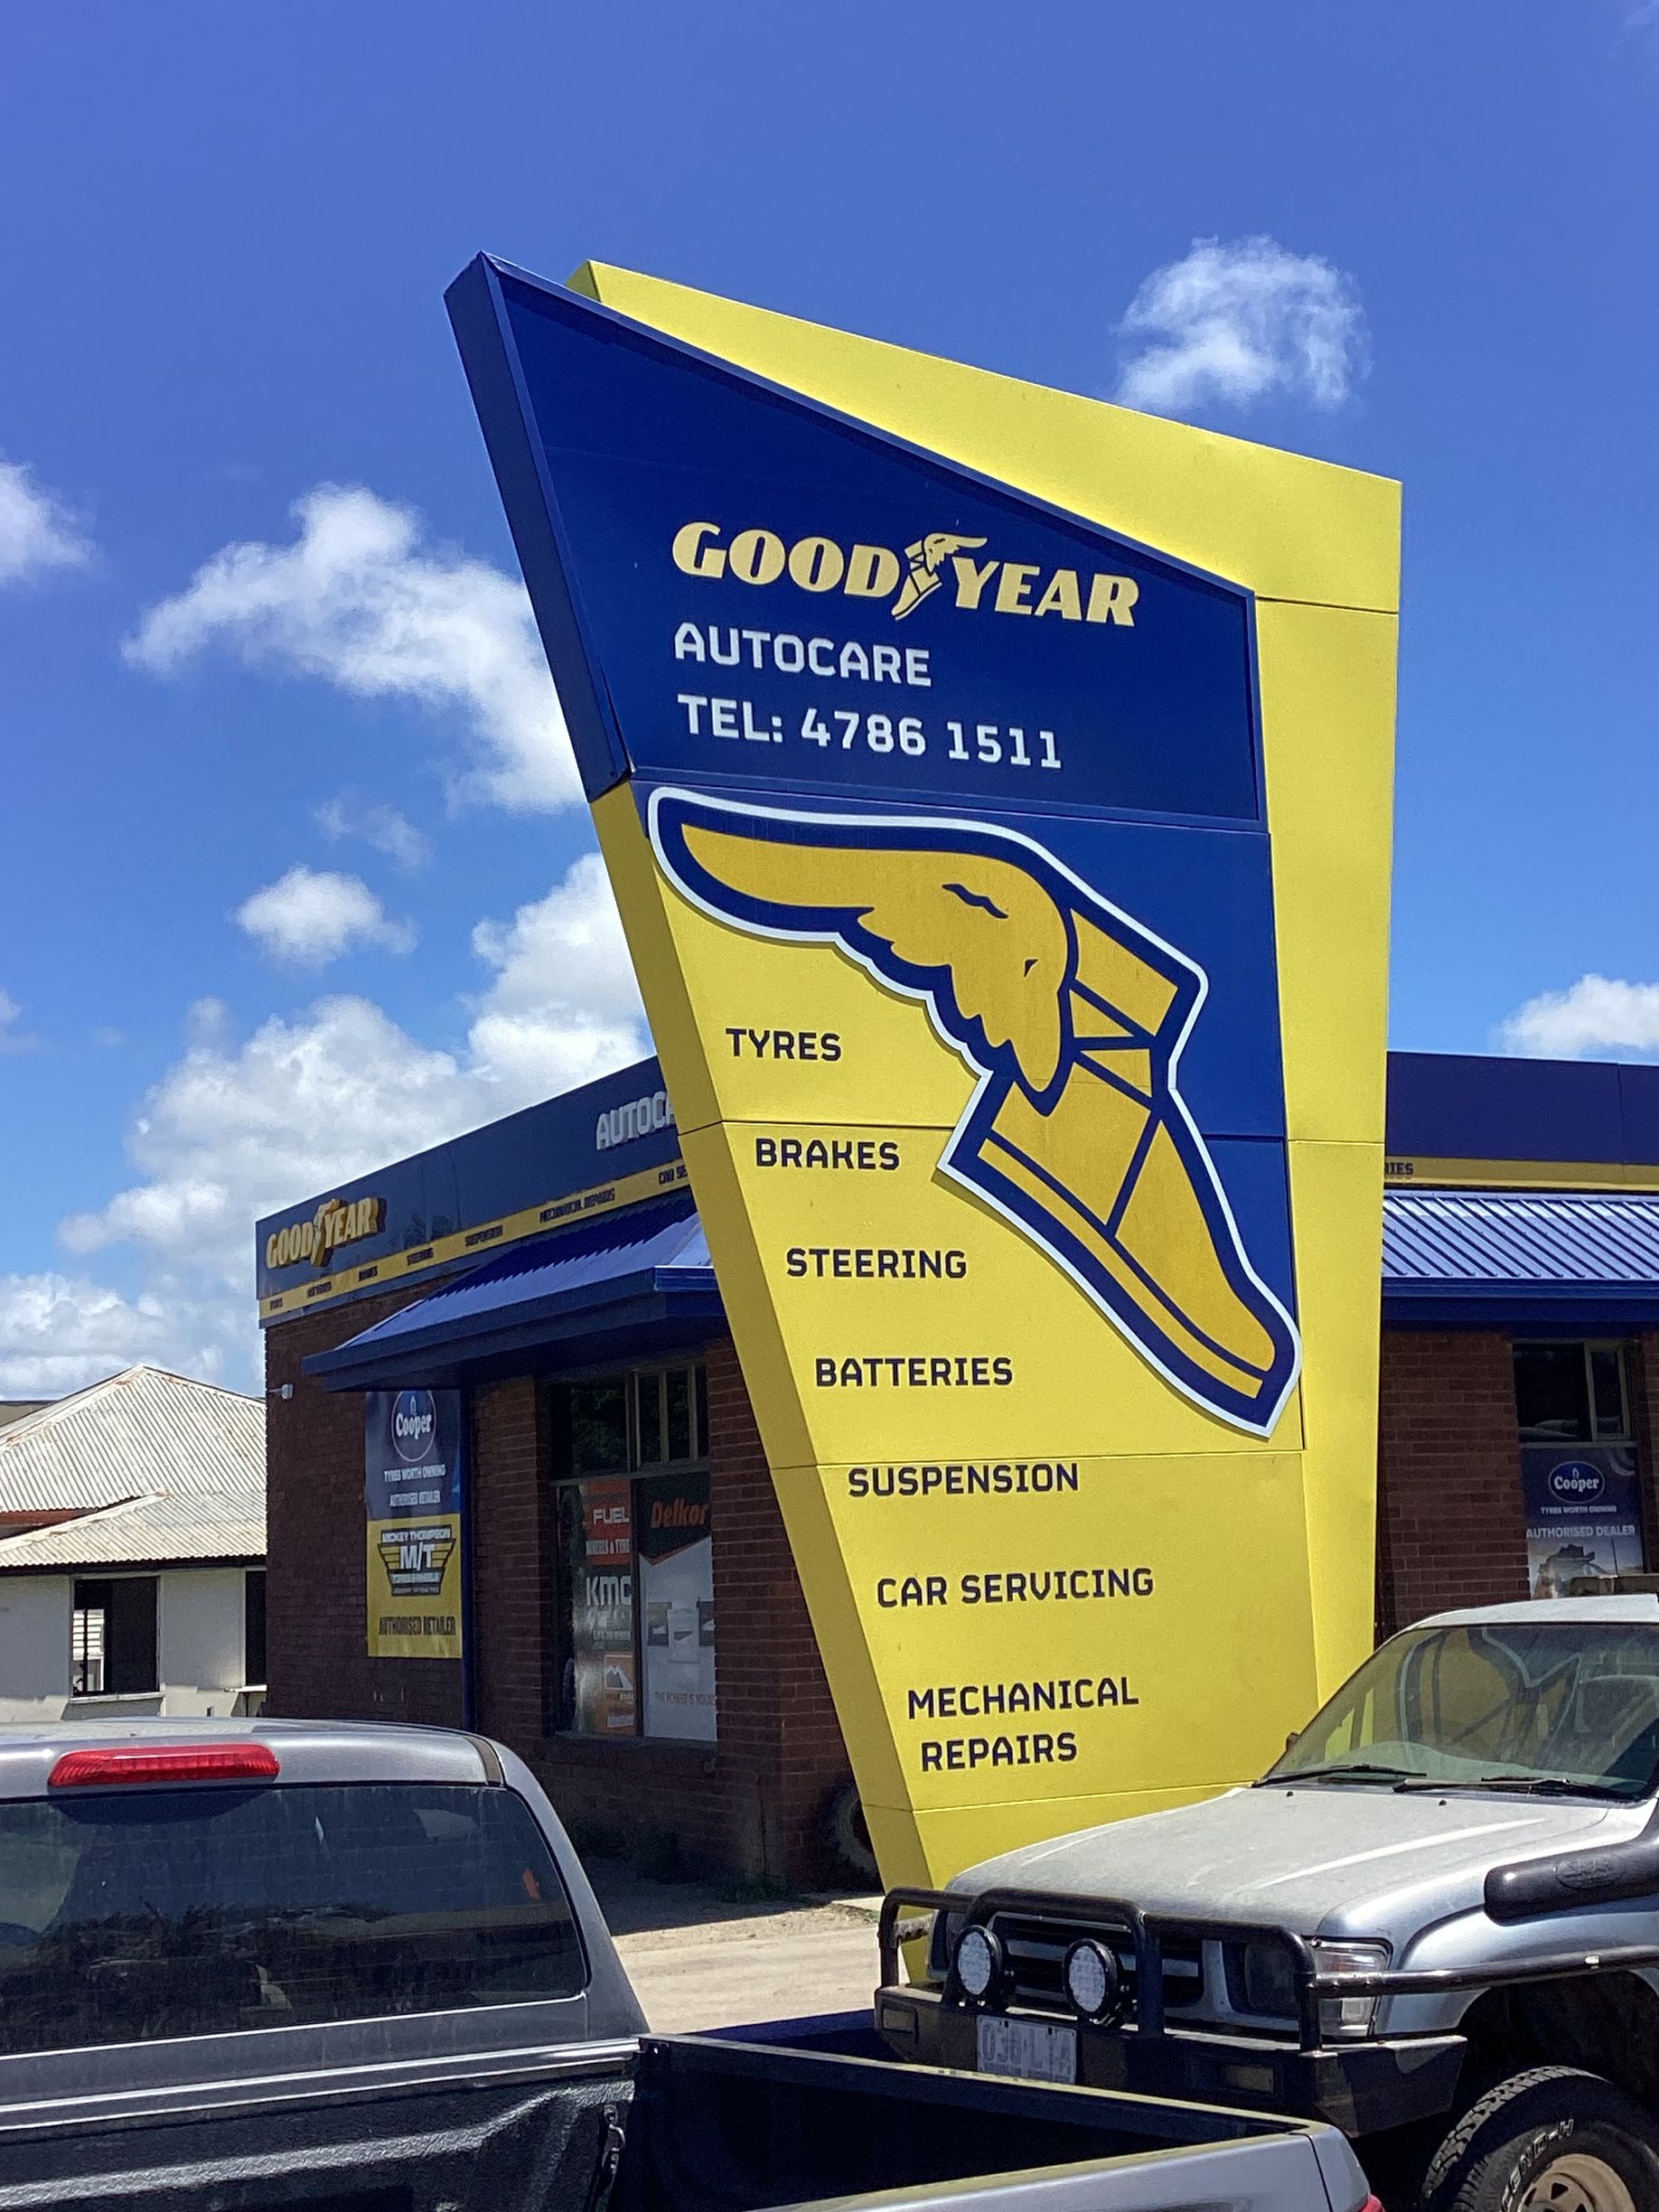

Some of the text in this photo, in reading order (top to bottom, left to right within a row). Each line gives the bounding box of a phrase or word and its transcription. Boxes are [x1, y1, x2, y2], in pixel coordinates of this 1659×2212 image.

[672, 521, 1139, 626] GOODYEAR
[674, 623, 932, 687] AUTOCARE
[677, 694, 1062, 769] TEL: 4786 1511
[725, 1028, 841, 1061] TYRES
[755, 1139, 900, 1169] BRAKES
[266, 1197, 379, 1270] GOODYEAR
[786, 1248, 967, 1278] STEERING
[816, 1357, 1012, 1387] BATTERIES
[396, 1412, 432, 1439] Cooper
[848, 1463, 1078, 1496] SUSPENSION
[1553, 1476, 1599, 1492] Cooper
[593, 1506, 630, 1525] FUEL
[651, 1497, 709, 1528] Delkor
[1526, 1525, 1635, 1538] AUTHORISED DEALER
[400, 1542, 435, 1570] M/T
[877, 1569, 1154, 1607] CAR SERVICING
[908, 1677, 1139, 1719] MECHANICAL
[922, 1732, 1077, 1771] REPAIRS
